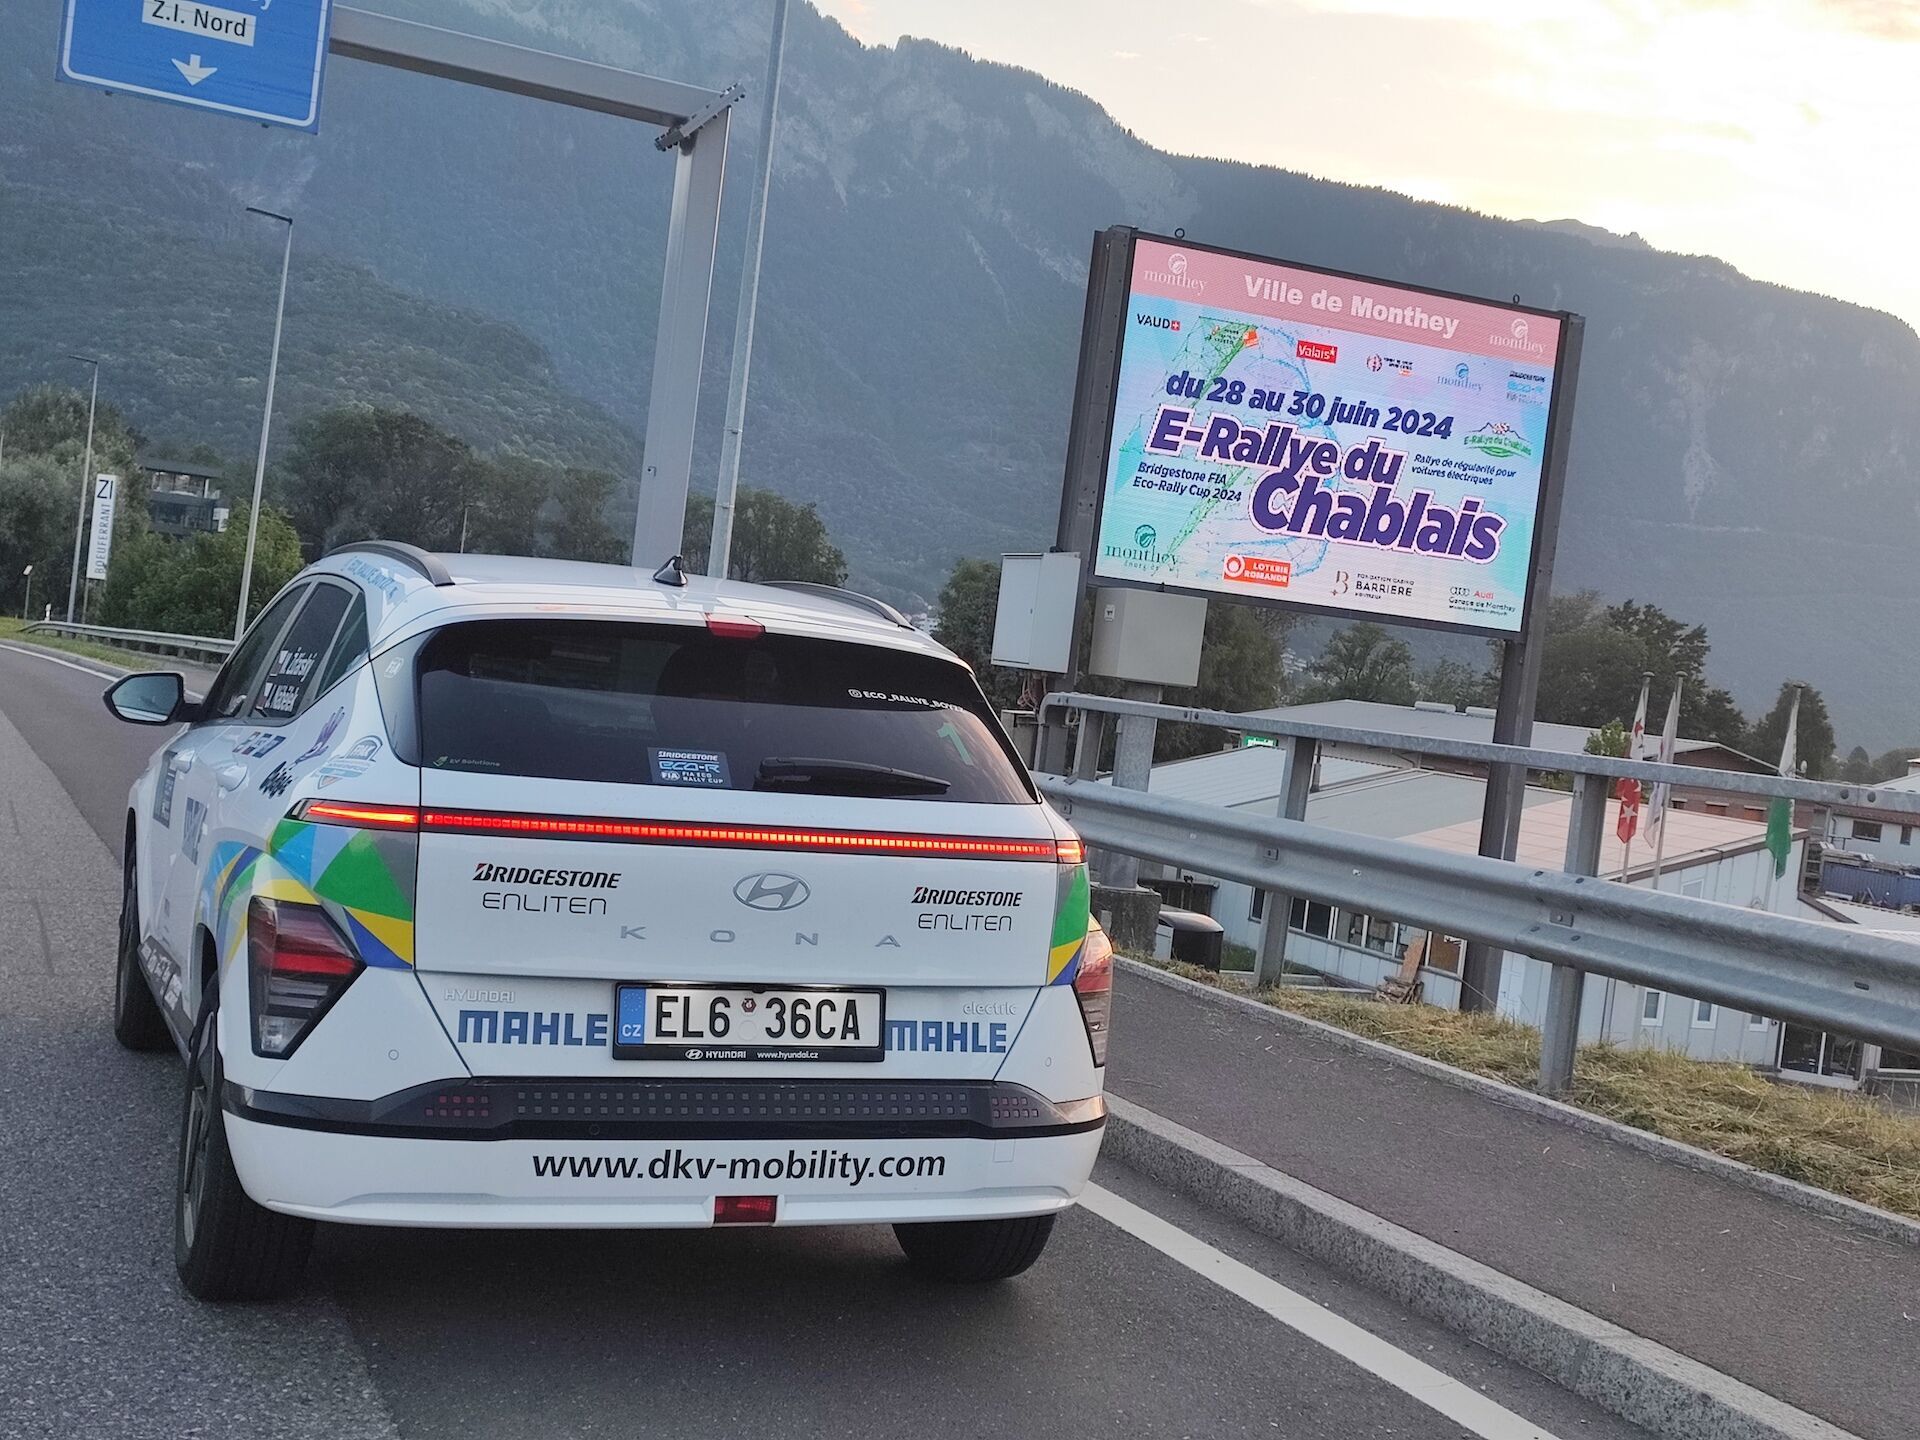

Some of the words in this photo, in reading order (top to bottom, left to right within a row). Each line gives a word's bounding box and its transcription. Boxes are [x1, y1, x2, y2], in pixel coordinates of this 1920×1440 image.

[151, 0, 186, 25] Z.I.
[193, 8, 248, 37] Nord
[1244, 275, 1304, 305] Ville
[1310, 289, 1343, 313] de
[1350, 296, 1460, 339] Monthey
[1136, 313, 1171, 329] VAUD
[1298, 344, 1331, 361] Valais
[1166, 371, 1205, 399] du
[1207, 377, 1247, 404] 28
[1248, 388, 1285, 413] au
[1288, 390, 1326, 419] 30
[1325, 396, 1380, 428] juin
[1382, 407, 1455, 440] 2024
[1150, 408, 1338, 478] E-Rallye
[1344, 440, 1404, 485] du
[1137, 461, 1206, 483] Bridgestone
[1207, 472, 1228, 486] FIA
[1411, 465, 1446, 479] voitures
[1414, 453, 1441, 467] Rallye
[1441, 457, 1453, 469] de
[1494, 468, 1517, 480] pour
[97, 479, 114, 500] ZI
[1132, 475, 1188, 496] Eco-Rally
[1189, 484, 1211, 500] Cup
[1212, 488, 1243, 503] 2024
[1252, 470, 1503, 561] Chablais
[1252, 561, 1289, 575] LOTERIE
[658, 751, 719, 761] BRIDGESTONE
[472, 863, 622, 889] BRIDGESTONE
[910, 886, 1023, 908] BRIDGESTONE
[443, 988, 516, 1004] HYUNDAI
[962, 1001, 1017, 1016] electric
[458, 1010, 609, 1047] MAHLE
[621, 1023, 642, 1038] CZ
[655, 996, 731, 1038] EL6
[765, 997, 860, 1041] 36CA
[884, 1020, 1007, 1053] MAHLE
[705, 1050, 747, 1059] HYUNDAI
[756, 1050, 819, 1060] www.hyundai.cz
[532, 1149, 946, 1186] www.dkv-mobility.com
